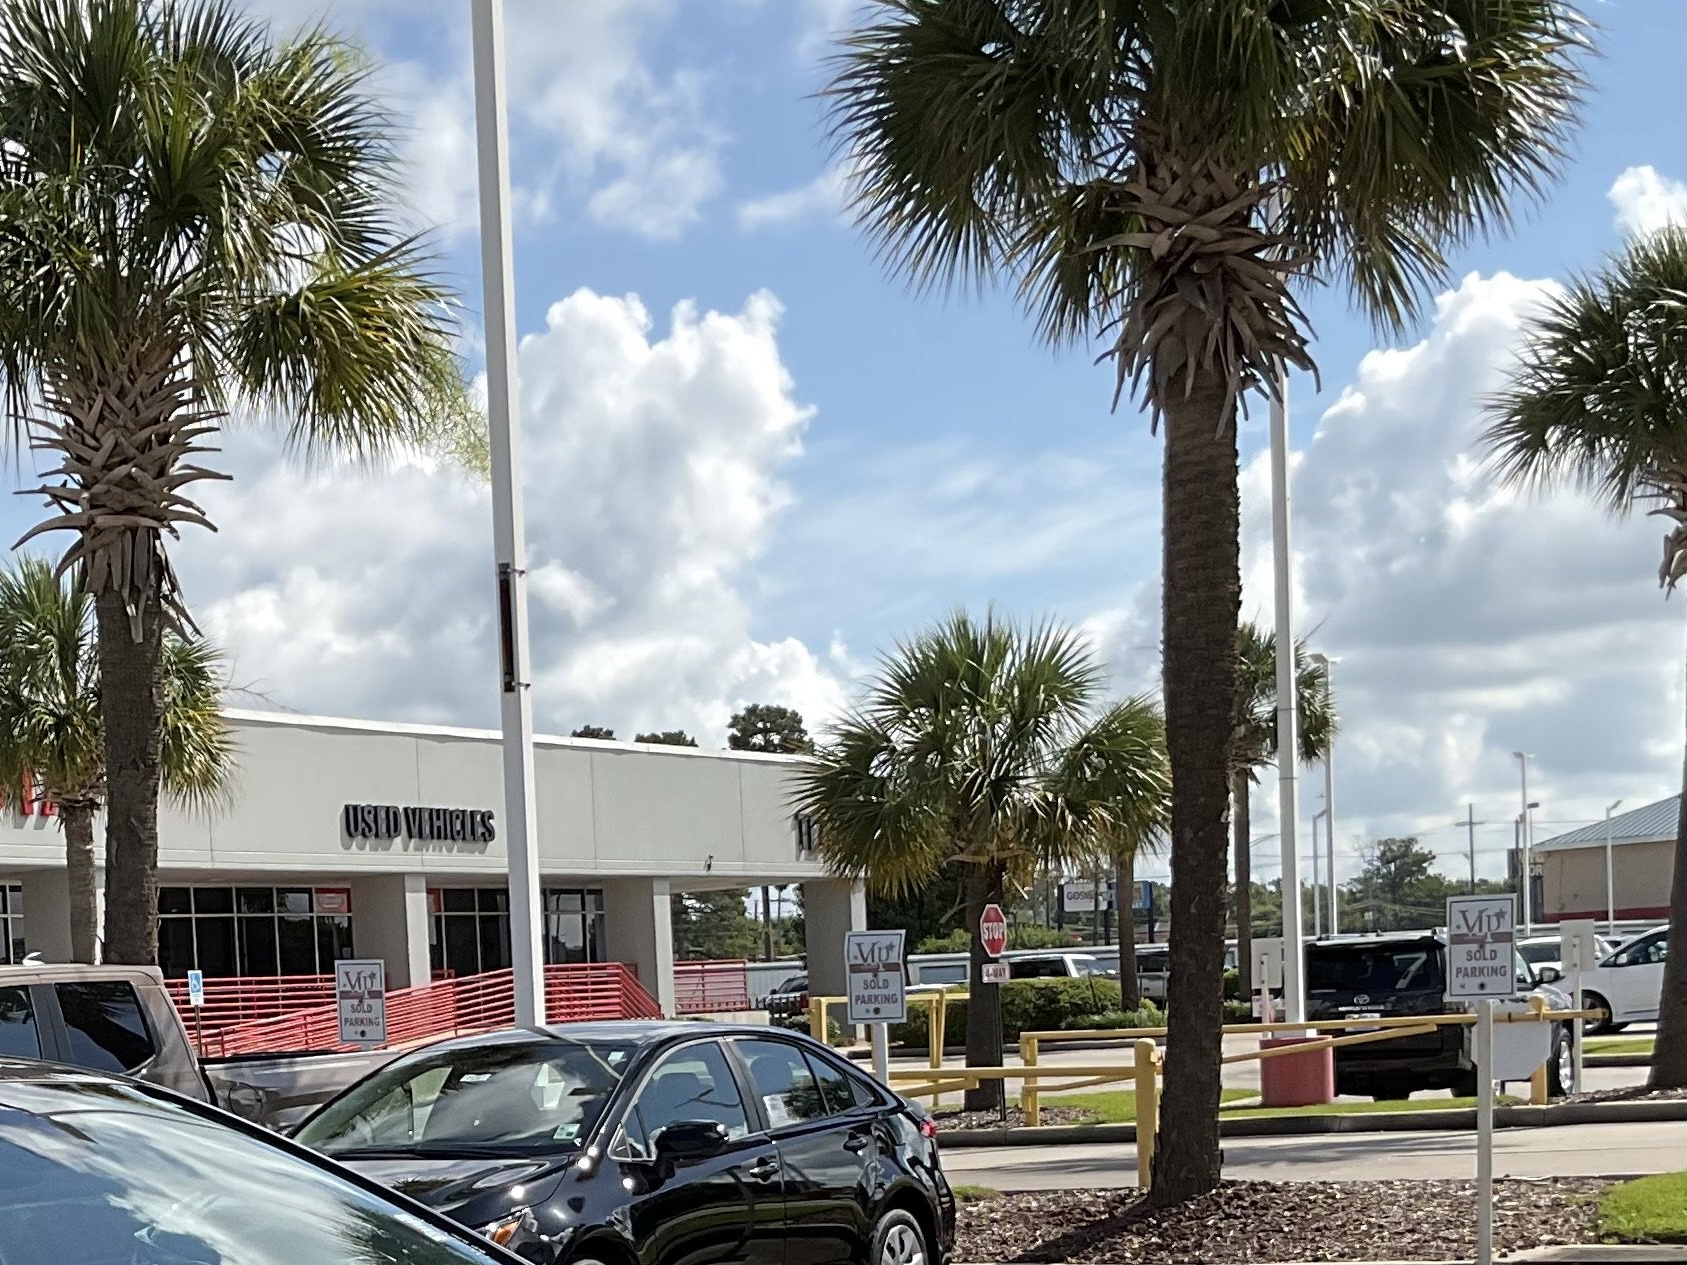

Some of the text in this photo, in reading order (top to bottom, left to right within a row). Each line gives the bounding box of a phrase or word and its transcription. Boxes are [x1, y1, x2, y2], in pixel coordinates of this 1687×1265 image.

[345, 804, 495, 842] USED VEHICLES
[983, 922, 1004, 940] STOP
[1465, 950, 1497, 961] SOLD
[985, 967, 1006, 978] 4-WAY
[1456, 965, 1507, 978] PARKING
[863, 979, 889, 990] SOLD
[855, 993, 898, 1005] PARKING
[350, 1003, 373, 1013] SOLD
[344, 1017, 380, 1026] PARKING
